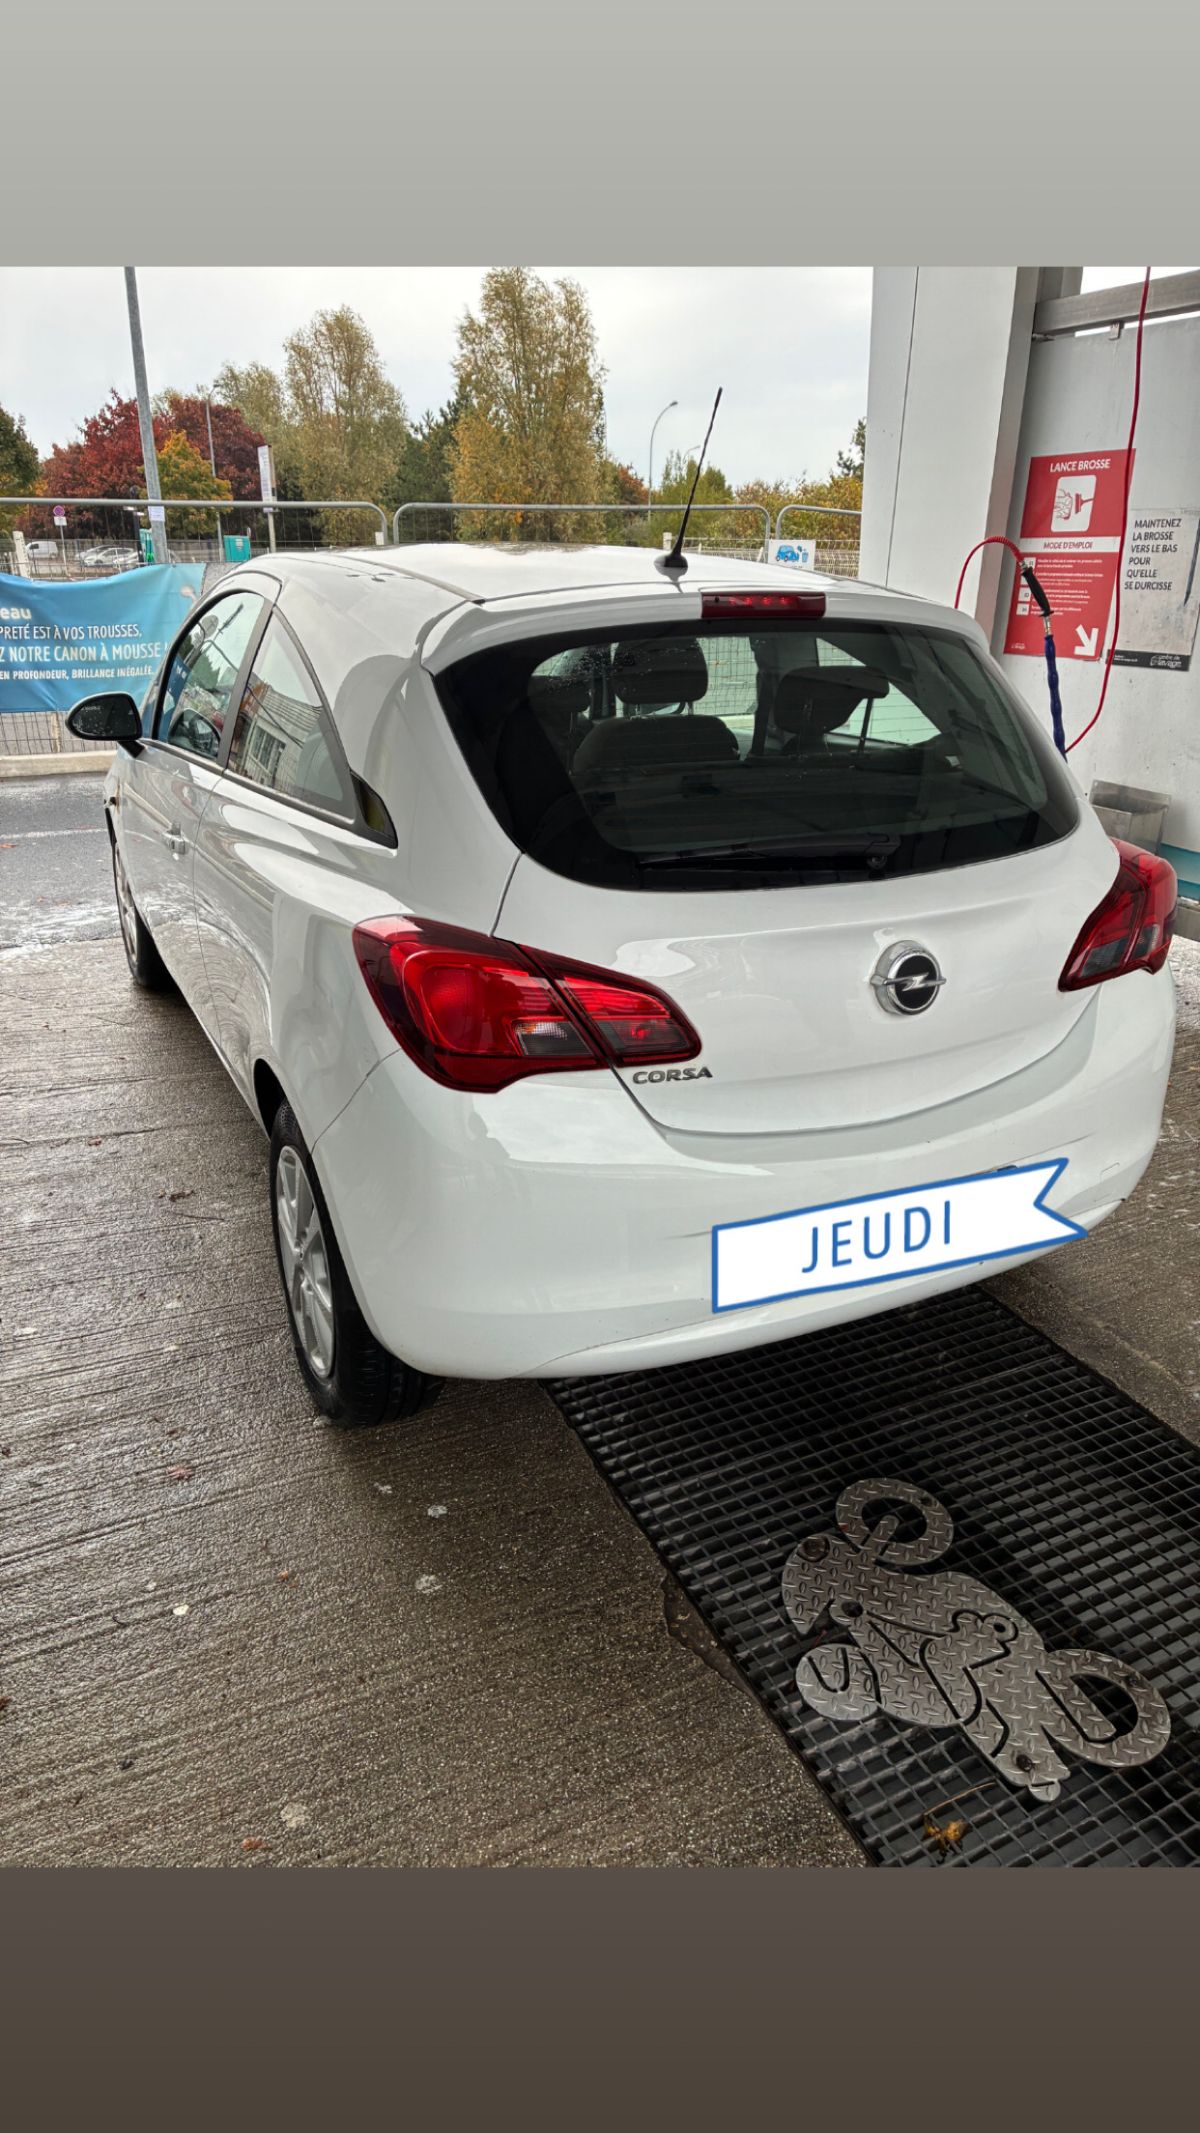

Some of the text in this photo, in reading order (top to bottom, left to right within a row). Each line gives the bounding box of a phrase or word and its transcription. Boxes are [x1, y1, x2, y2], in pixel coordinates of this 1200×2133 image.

[1050, 458, 1111, 473] LANCE BROSSE
[1134, 518, 1182, 529] MAINTENEZ
[1132, 531, 1174, 541] LA BROSSE
[1043, 541, 1093, 549] MODE D'EMPLOI
[1131, 544, 1178, 553] VERS LE BAS
[1128, 556, 1151, 566] POUR
[1126, 569, 1158, 579] QU'ELLE
[1124, 581, 1173, 591] SE DURCISSE
[0, 607, 32, 620] eau
[33, 626, 51, 640] EST
[54, 624, 61, 640] À
[63, 626, 85, 640] VOS
[87, 624, 142, 640] TROUSSES,
[9, 646, 51, 662] NOTRE
[54, 646, 97, 662] CANON
[100, 642, 109, 661] À
[112, 642, 161, 660] MOUSSE
[0, 670, 10, 680] EN
[13, 669, 69, 680] PROFONDEUR,
[72, 668, 115, 679] BRILLANCE
[633, 1066, 713, 1085] CORSA
